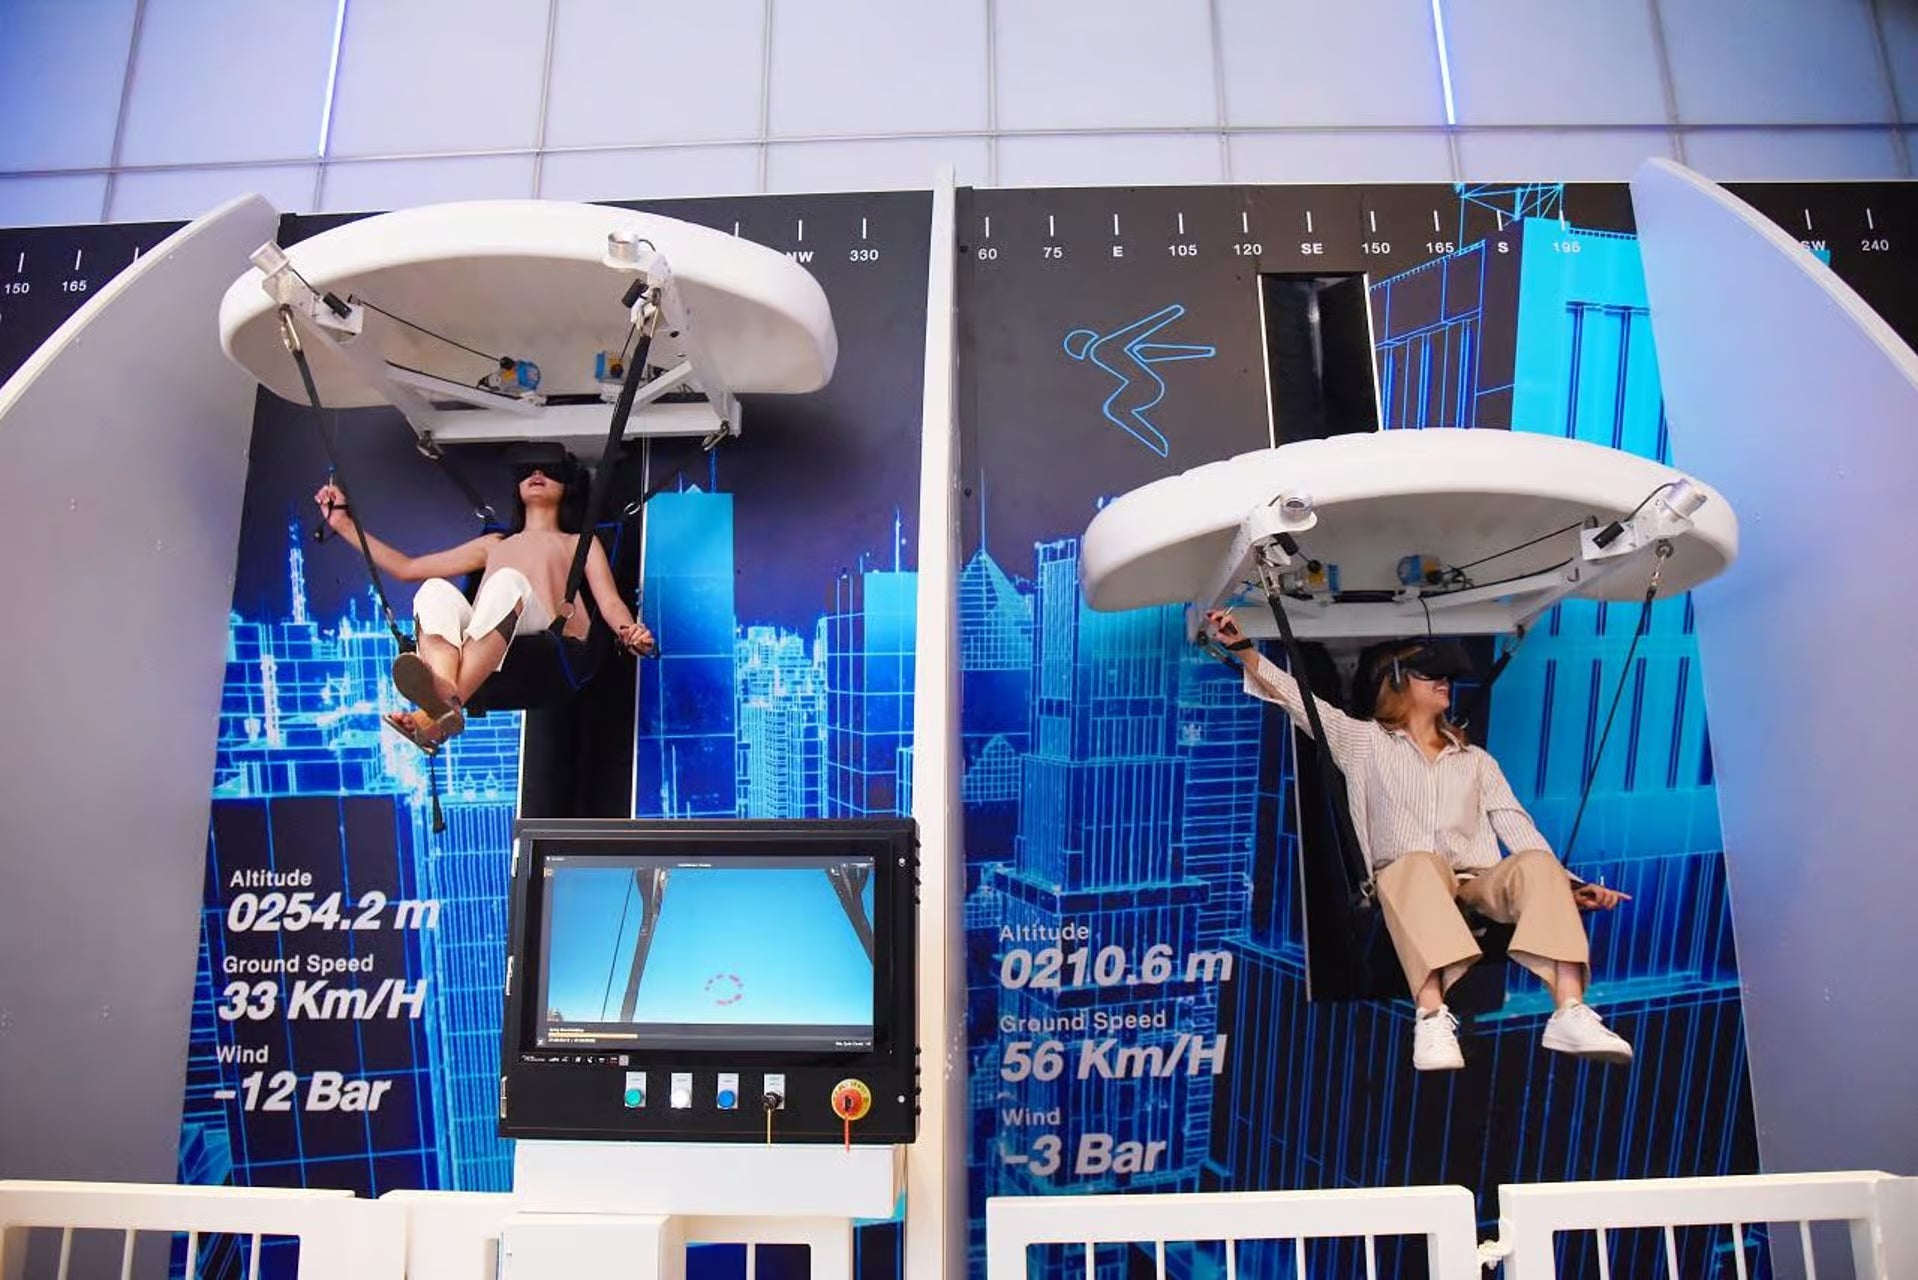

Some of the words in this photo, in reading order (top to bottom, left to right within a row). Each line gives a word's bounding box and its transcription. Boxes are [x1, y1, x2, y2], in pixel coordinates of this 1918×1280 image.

[849, 249, 879, 262] 330
[978, 248, 998, 261] 60
[1043, 247, 1063, 259] 75
[1113, 246, 1123, 258] E
[1168, 244, 1198, 257] 105
[1233, 243, 1263, 256] 120
[1301, 243, 1324, 256] SE
[1362, 242, 1391, 255] 150
[1426, 242, 1455, 254] 165
[1498, 242, 1509, 254] S
[1861, 239, 1889, 251] 240
[4, 282, 30, 294] 150
[61, 279, 87, 292] 165
[229, 869, 313, 888] Altitude
[227, 890, 387, 932] 0254.2
[393, 898, 441, 930] m
[999, 923, 1090, 942] Altitude
[222, 954, 300, 973] Ground
[306, 953, 374, 976] Speed
[1000, 944, 1173, 990] 0210.6
[1184, 950, 1233, 982] m
[218, 980, 279, 1021] 33
[286, 979, 428, 1020] Km/H
[1000, 1012, 1086, 1033] Ground
[1093, 1010, 1167, 1034] Speed
[216, 1045, 270, 1063] Wind
[1000, 1040, 1065, 1082] 56
[1076, 1034, 1228, 1080] Km/H
[305, 1071, 392, 1112] Bar
[1002, 1107, 1062, 1126] Wind
[1074, 1133, 1167, 1175] Bar
